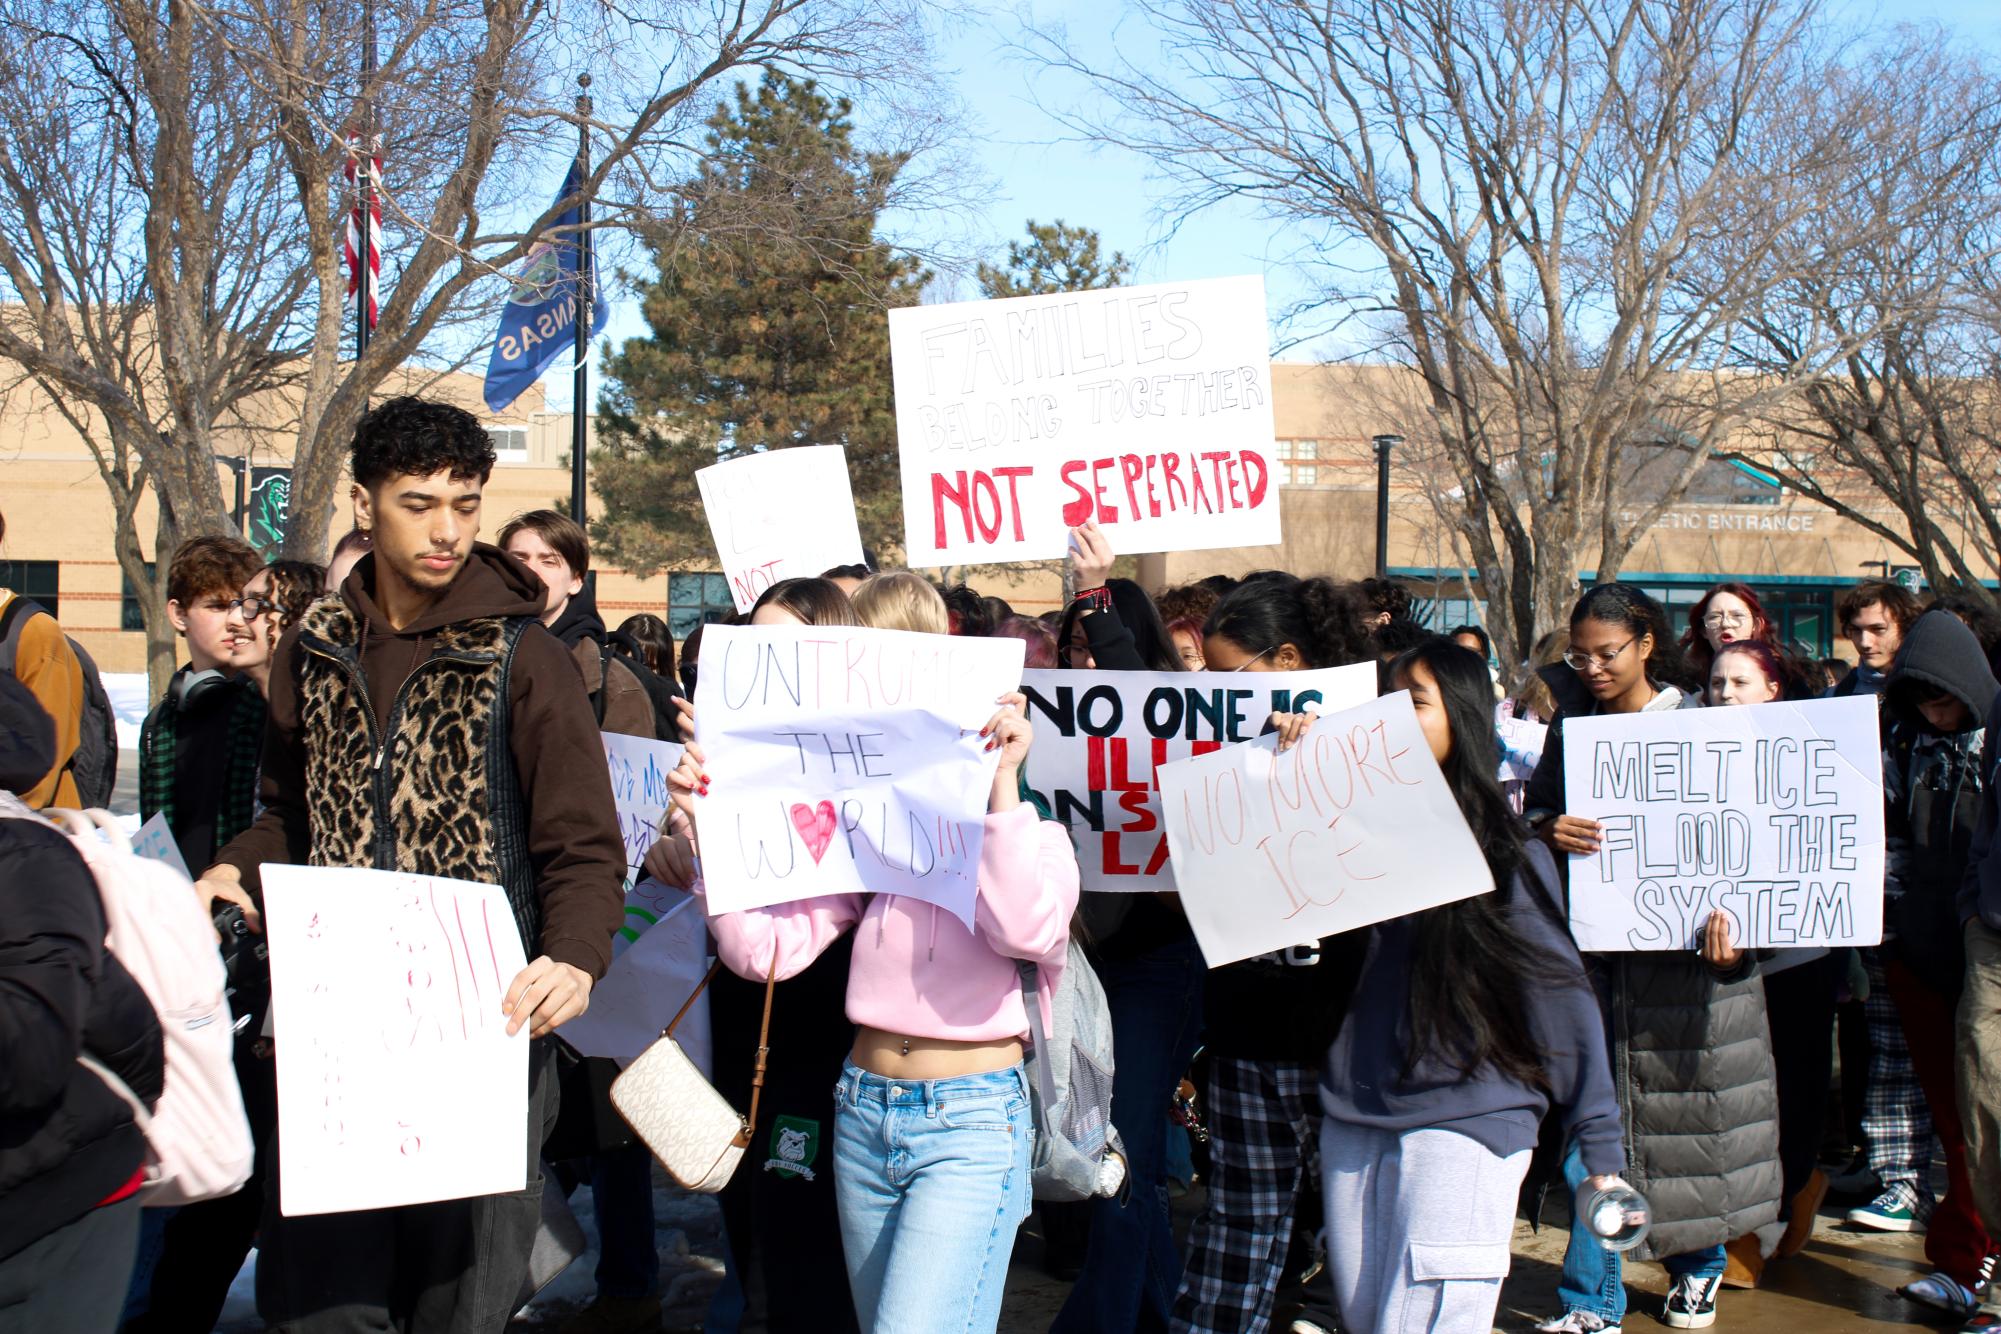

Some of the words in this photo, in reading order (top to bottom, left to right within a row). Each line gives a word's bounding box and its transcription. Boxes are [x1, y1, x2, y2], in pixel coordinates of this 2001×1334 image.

[921, 291, 1203, 395] FAMILIES
[917, 394, 1062, 453] BELONG
[1078, 366, 1264, 424] TOGETHER
[931, 465, 1034, 549] NOT
[1060, 449, 1269, 527] SEPERATED
[1707, 513, 1814, 532] ENTRANCE
[734, 558, 784, 606] NOT
[1020, 684, 1124, 738] NO
[1143, 686, 1254, 743] ONE
[773, 732, 892, 777] THE
[1183, 767, 1245, 855] NO
[1268, 718, 1424, 833] MORE
[1592, 740, 1742, 803] MELT
[1755, 737, 1838, 810] ICE
[1256, 814, 1387, 920] ICE
[1597, 809, 1750, 883] FLOOD
[1769, 814, 1857, 874] THE
[1627, 878, 1854, 950] SYSTEM
